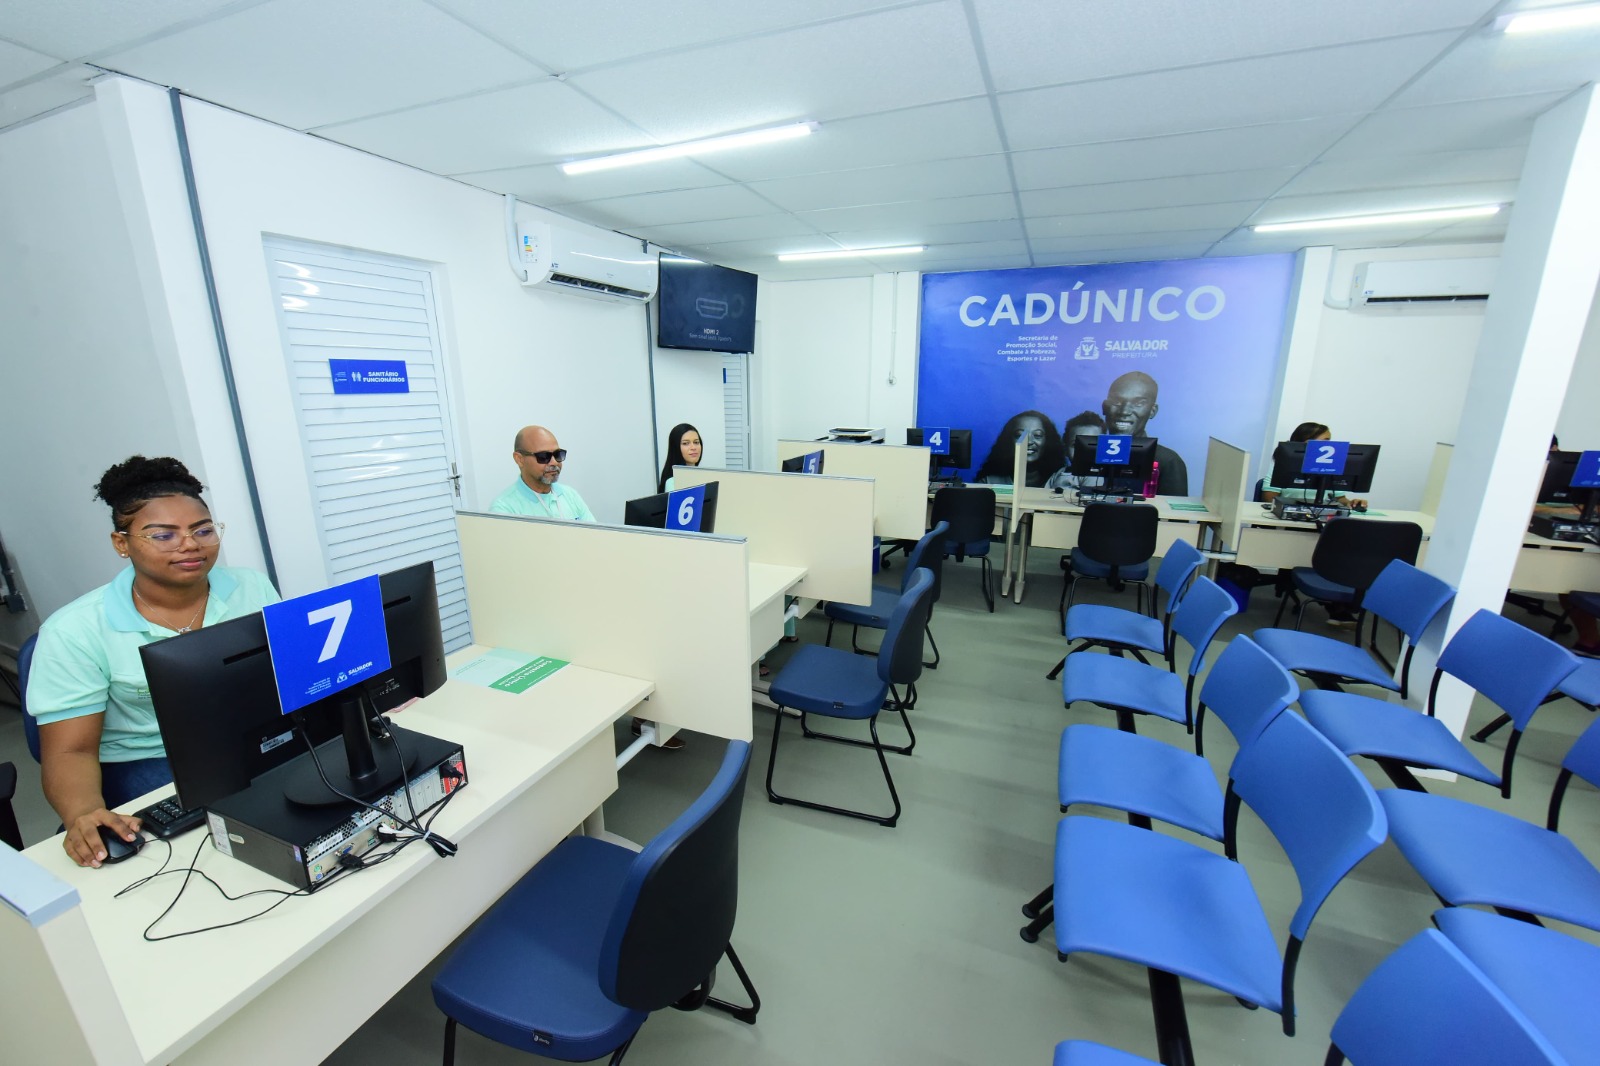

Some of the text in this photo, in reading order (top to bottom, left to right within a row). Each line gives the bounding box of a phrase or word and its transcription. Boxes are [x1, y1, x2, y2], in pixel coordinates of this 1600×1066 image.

[959, 281, 1226, 327] CADÚNICO
[1104, 339, 1169, 351] SALVADOR
[929, 431, 943, 446] 4
[1105, 439, 1121, 455] 3
[1315, 445, 1336, 464] 2
[808, 457, 816, 474] 5
[677, 496, 695, 526] 6
[307, 599, 353, 664] 7
[348, 661, 373, 676] SALVADOR
